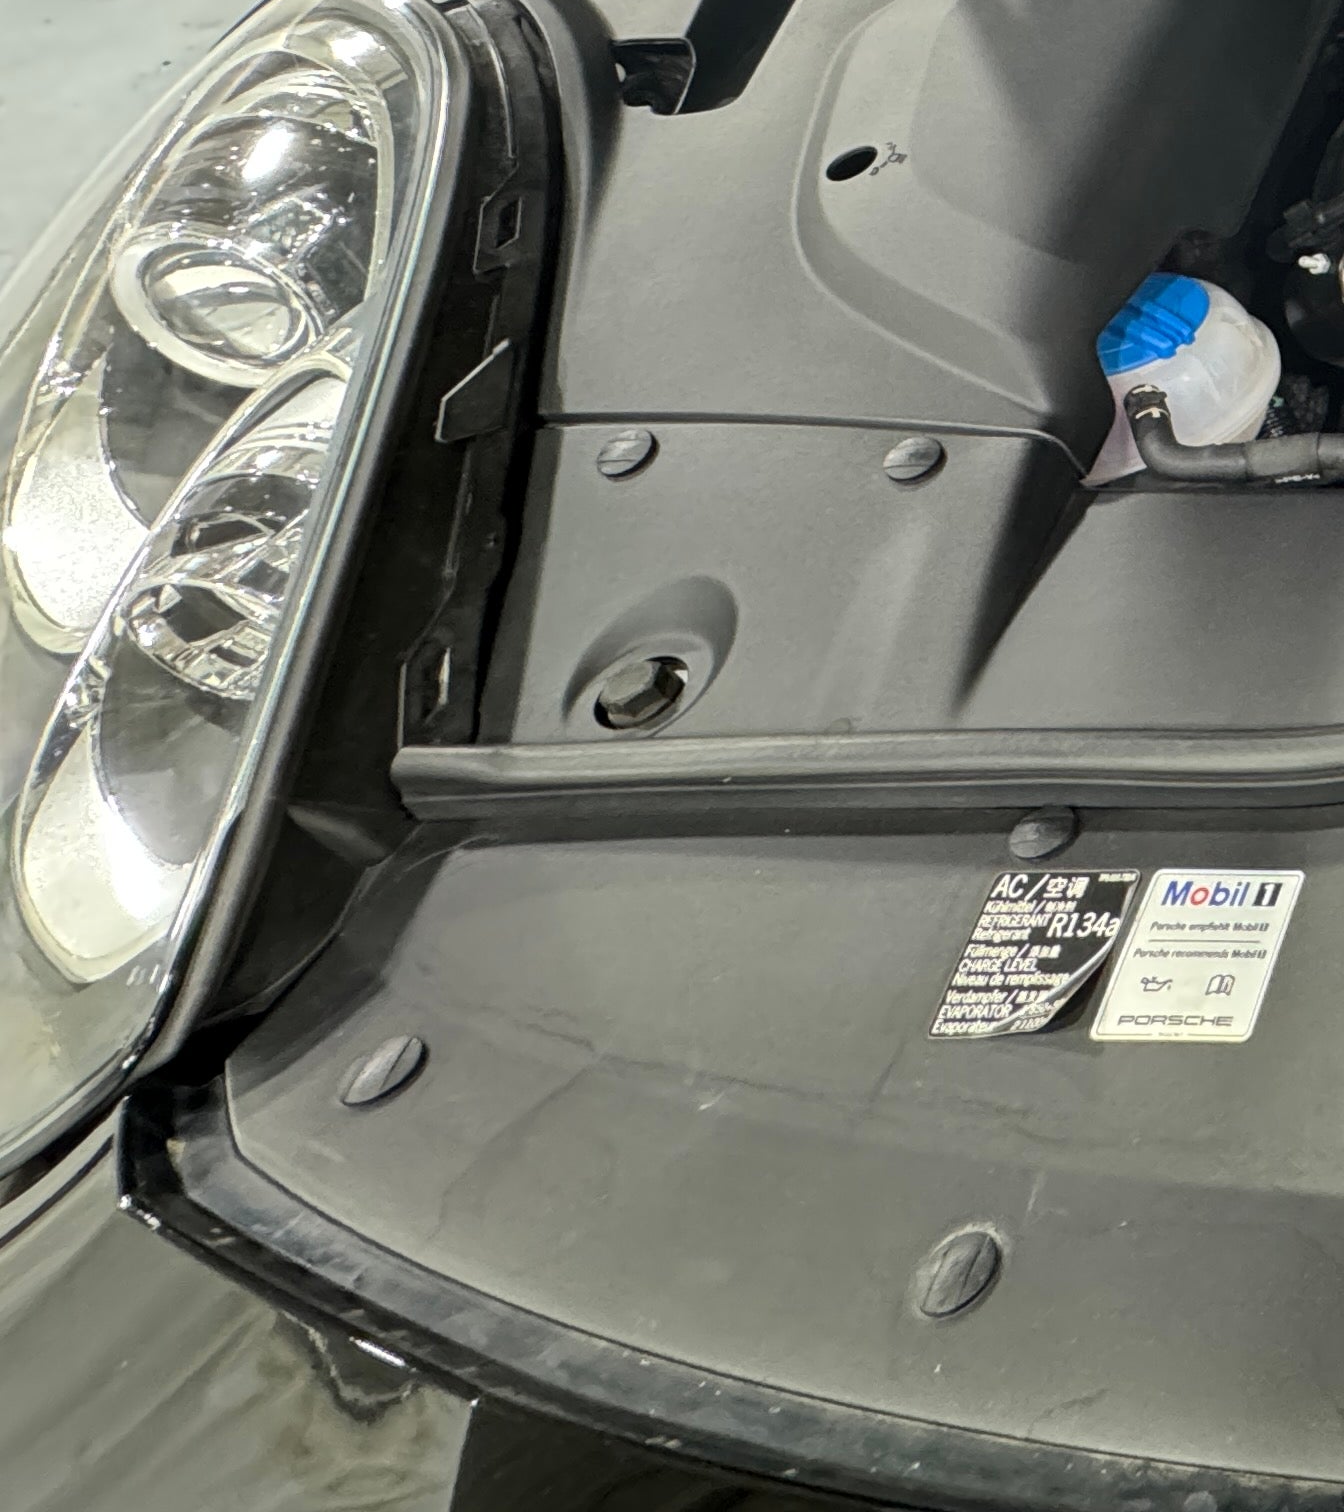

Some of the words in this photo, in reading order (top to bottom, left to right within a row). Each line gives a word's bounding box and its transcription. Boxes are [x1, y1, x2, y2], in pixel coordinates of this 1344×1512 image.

[990, 874, 1028, 899] AC
[1043, 876, 1090, 899] 空调
[1161, 880, 1251, 906] Mobil
[1256, 882, 1282, 907] 1
[978, 913, 1051, 927] REFRIGERANT
[1047, 912, 1121, 938] R134a
[1150, 921, 1186, 931] Porsche
[1188, 921, 1230, 932] empfiehlt
[1232, 922, 1259, 931] Mobil
[1133, 949, 1169, 959] Porsche
[1171, 949, 1229, 959] recommends
[1231, 949, 1257, 959] Mobil
[959, 959, 1002, 972] CHARGE
[1003, 959, 1039, 972] LEVEL
[953, 973, 990, 986] Niveau
[991, 973, 1005, 985] de
[939, 1004, 1013, 1019] EVAPORATOR
[1117, 1015, 1234, 1026] PORSCHE
